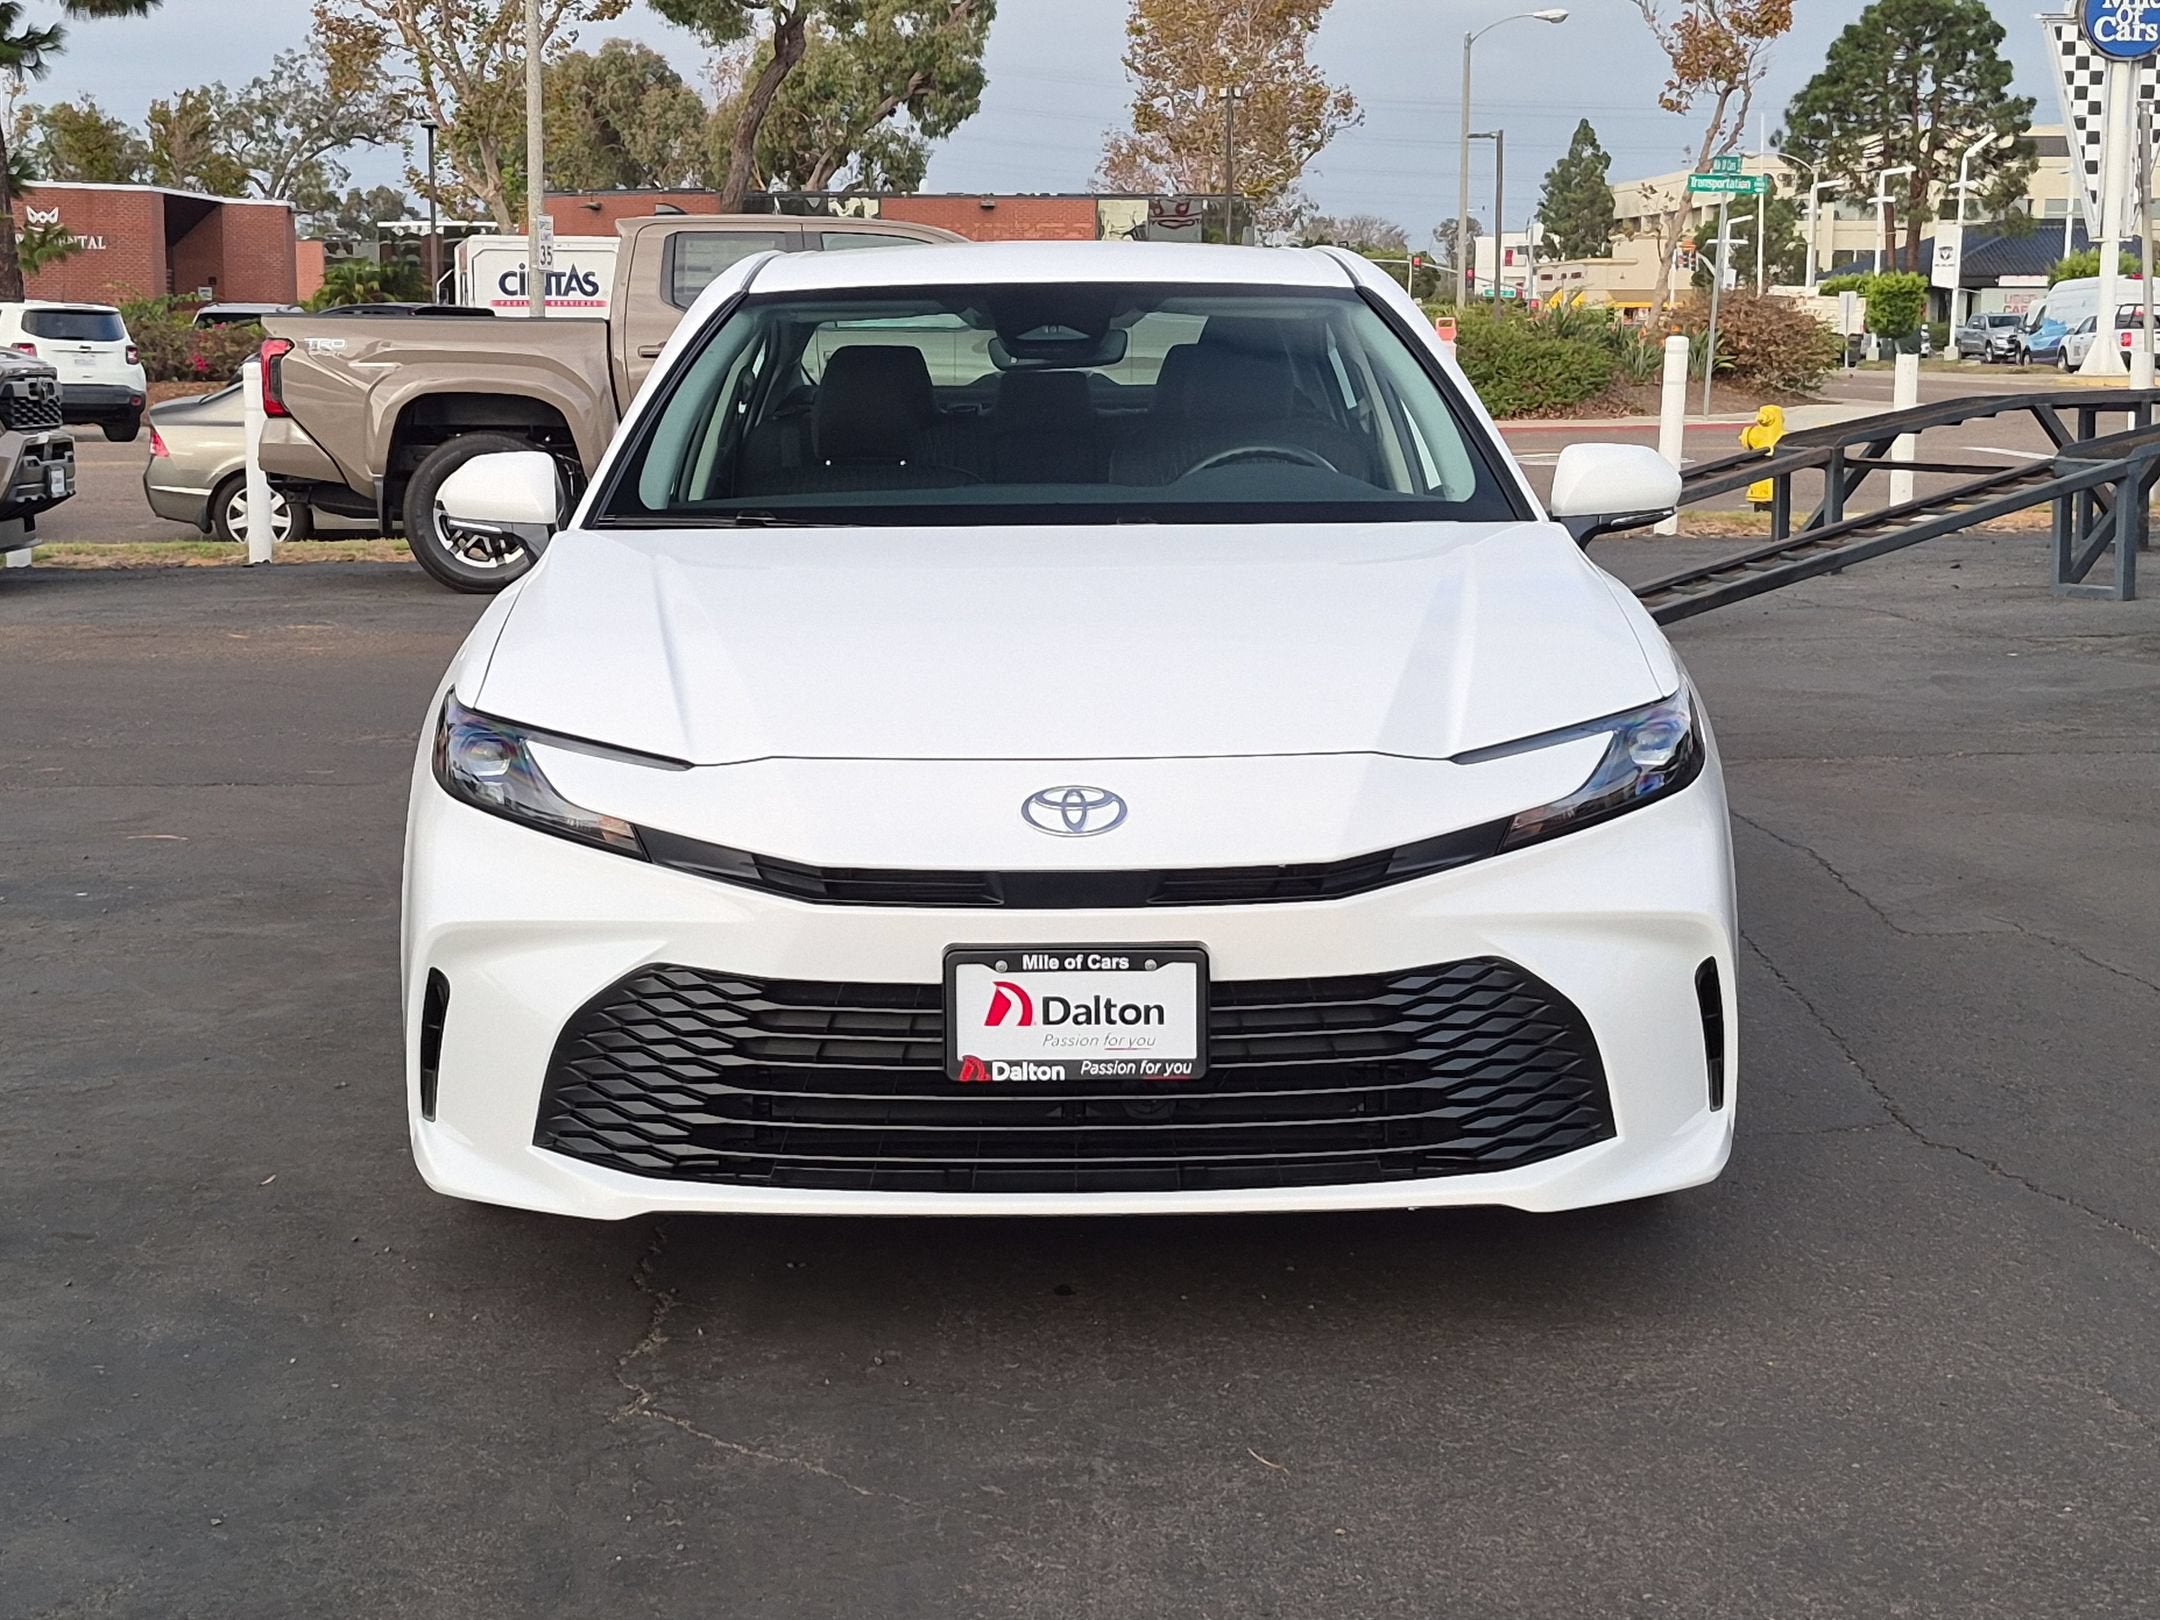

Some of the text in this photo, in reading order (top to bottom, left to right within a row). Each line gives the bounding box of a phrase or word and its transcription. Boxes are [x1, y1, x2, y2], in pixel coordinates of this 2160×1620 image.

[2094, 16, 2158, 42] Cars
[1690, 176, 1751, 190] Transportation
[540, 245, 553, 266] 35
[1022, 954, 1130, 970] Mile of Cars
[1042, 995, 1165, 1026] Dalton
[1043, 1033, 1156, 1049] Passion for you
[991, 1060, 1192, 1082] Dalton Passion for you
